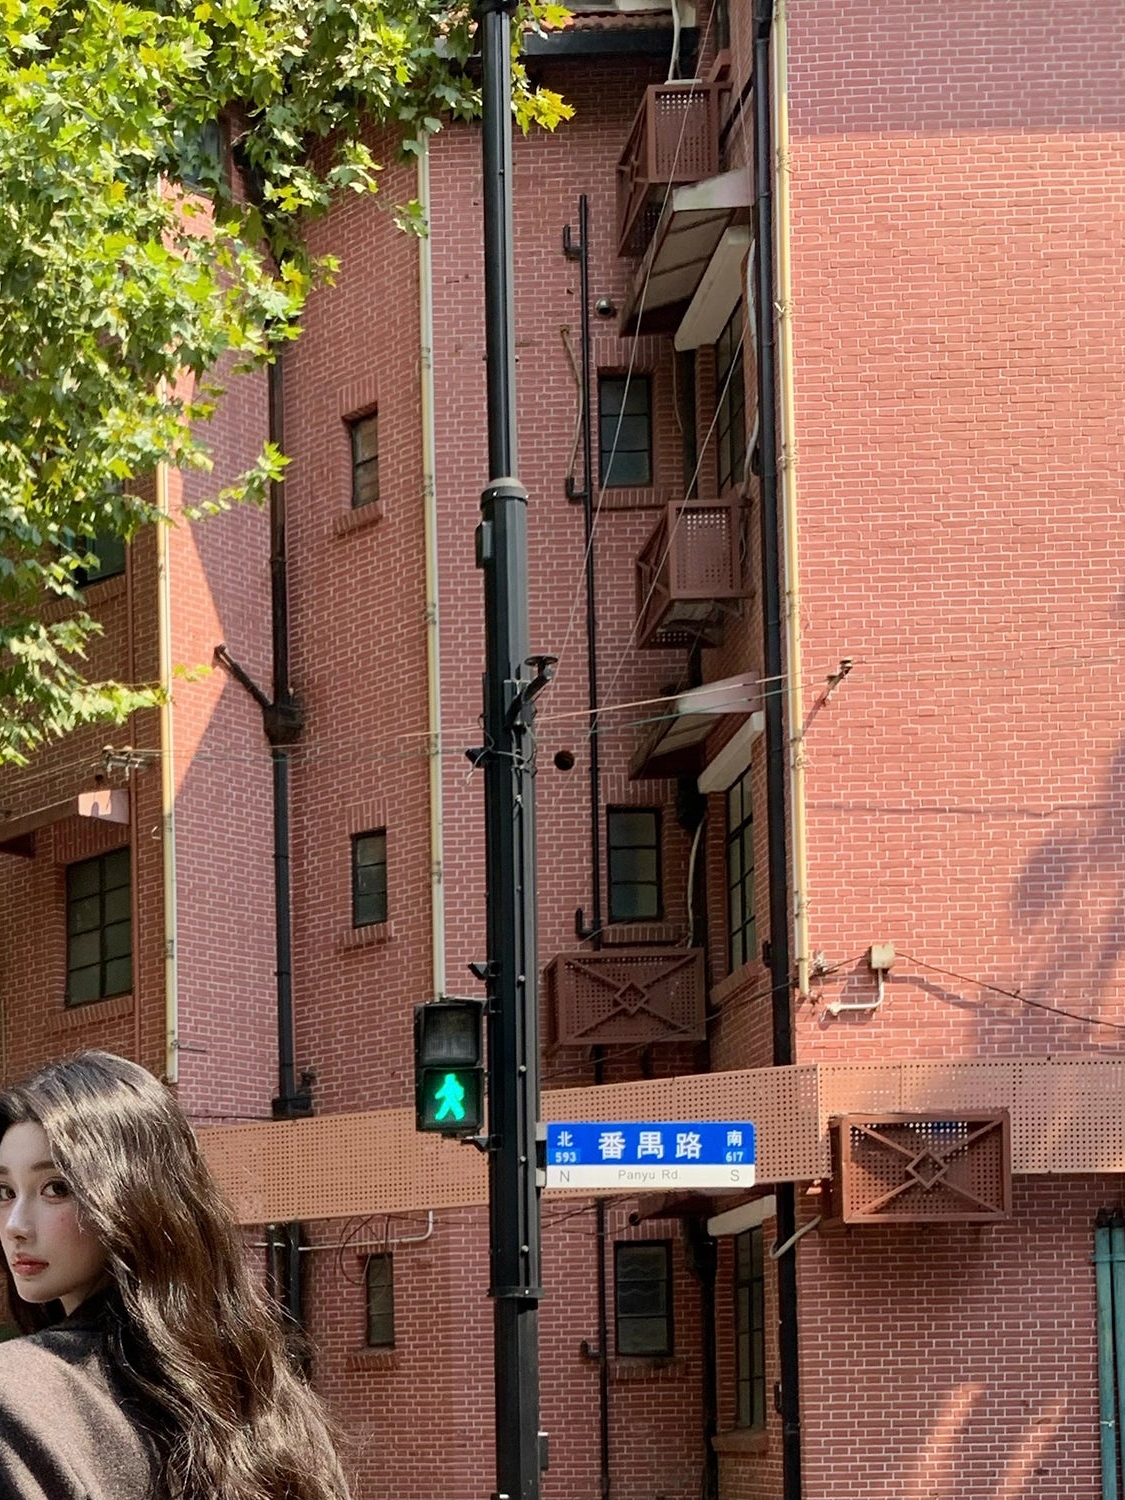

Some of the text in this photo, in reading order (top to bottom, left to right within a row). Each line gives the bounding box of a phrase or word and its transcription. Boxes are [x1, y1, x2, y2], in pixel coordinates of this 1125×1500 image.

[557, 1131, 574, 1148] 北
[598, 1130, 703, 1160] 番禺路
[726, 1130, 743, 1147] 南
[555, 1151, 577, 1163] 593
[725, 1151, 744, 1163] 617
[559, 1169, 571, 1183] N
[618, 1169, 682, 1182] Panyu Rd.
[730, 1169, 740, 1182] S
